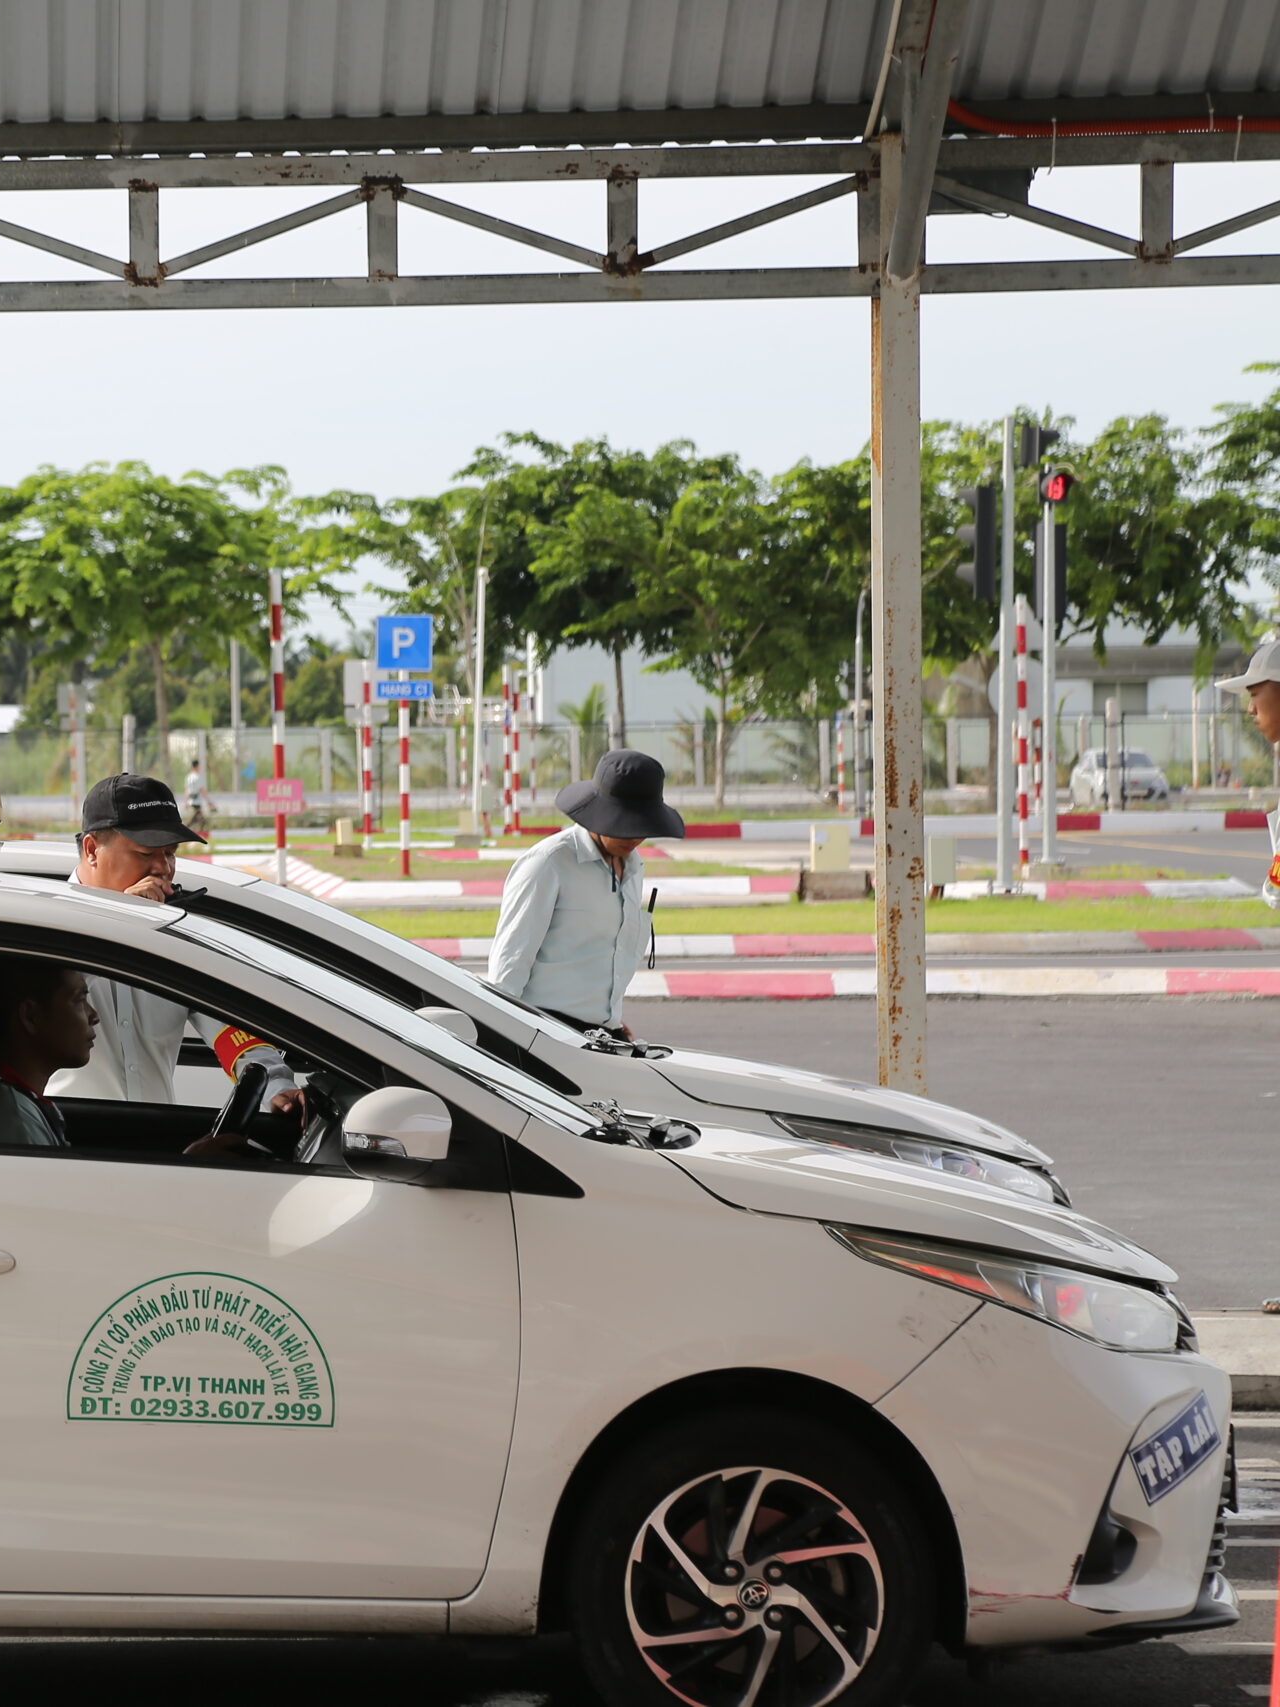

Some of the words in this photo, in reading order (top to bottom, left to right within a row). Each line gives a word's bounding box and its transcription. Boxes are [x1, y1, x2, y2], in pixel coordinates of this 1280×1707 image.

[392, 627, 416, 659] P
[192, 1285, 212, 1309] TƯ
[214, 1290, 251, 1317] PHÁT
[107, 1313, 130, 1344] CỔ
[150, 1322, 175, 1343] ĐÀO
[176, 1317, 200, 1336] TẠO
[205, 1314, 220, 1333] VÀ
[222, 1320, 246, 1341] SÁT
[249, 1304, 291, 1340] TRIỂN
[94, 1339, 117, 1360] TY
[127, 1336, 154, 1360] TÂM
[243, 1333, 274, 1363] HẠCH
[278, 1333, 309, 1363] HẬU
[79, 1359, 110, 1394] CÔNG
[112, 1358, 137, 1394] TRUNG
[266, 1360, 288, 1380] LÁI
[293, 1362, 320, 1400] GIANG
[198, 1377, 265, 1395] THANH
[273, 1382, 290, 1396] XE
[80, 1396, 121, 1415] ĐT:
[130, 1398, 322, 1421] 02933.607.999
[1137, 1436, 1184, 1488] TẬP
[1183, 1405, 1215, 1455] LÁI
